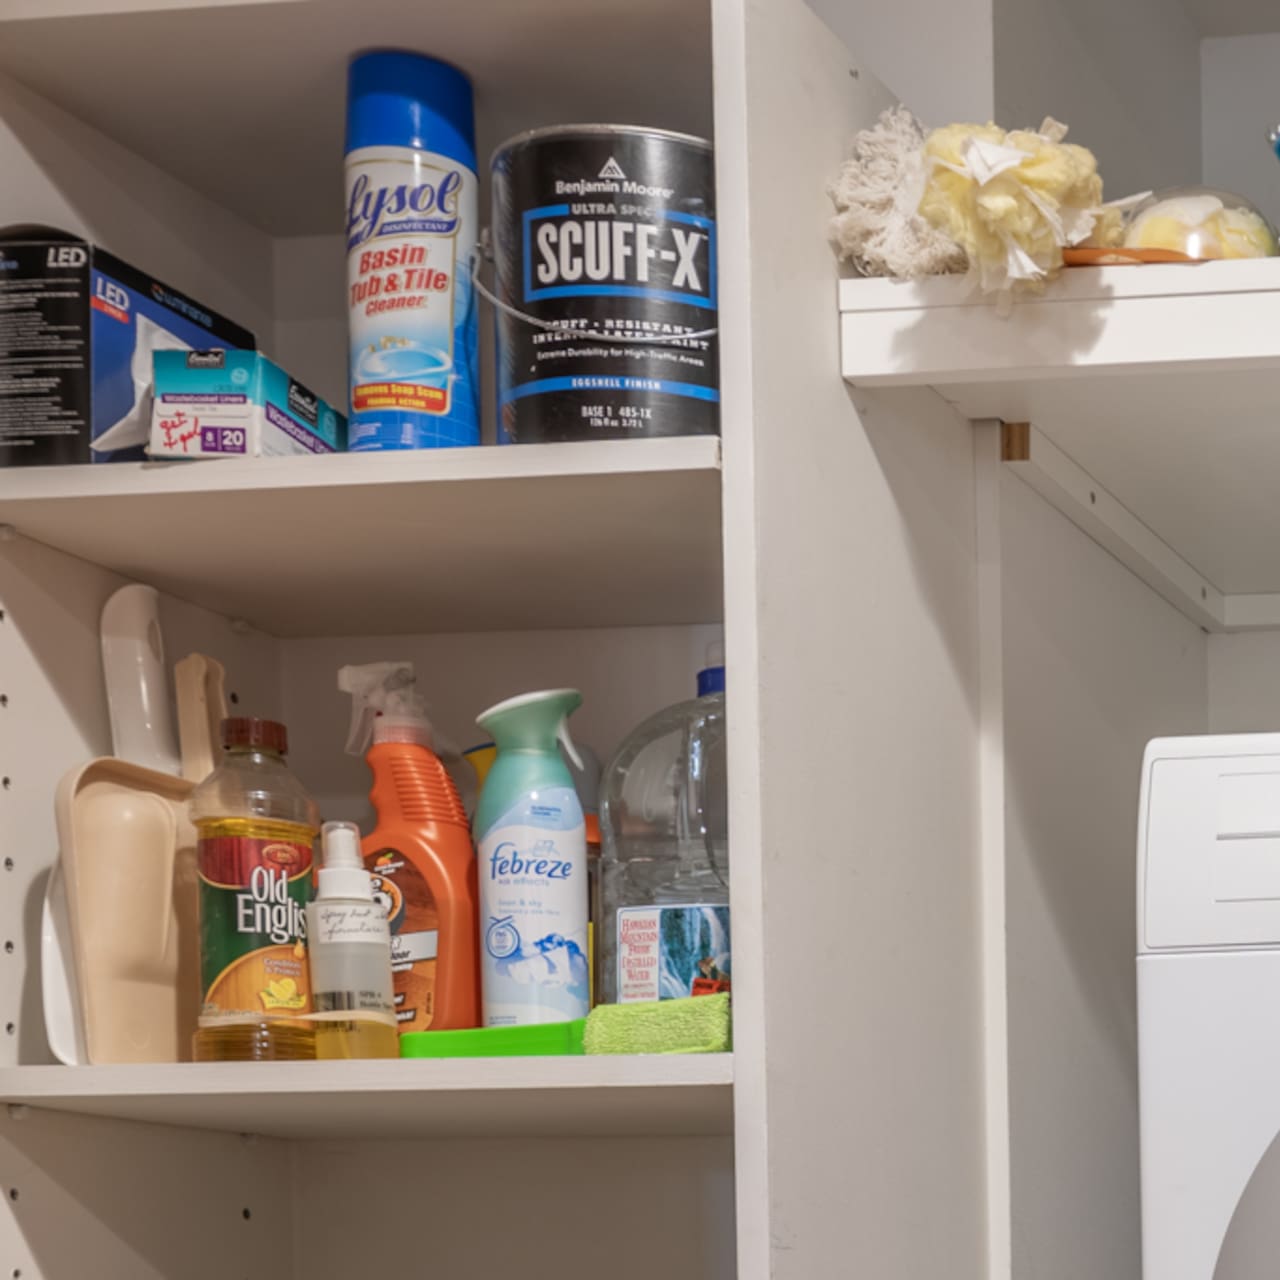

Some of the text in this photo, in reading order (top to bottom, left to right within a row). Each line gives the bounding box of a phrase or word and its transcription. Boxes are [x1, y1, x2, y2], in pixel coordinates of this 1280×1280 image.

[555, 178, 672, 198] Benjamin Moore
[345, 170, 461, 245] Lysol
[571, 202, 616, 215] ULTRA
[46, 246, 88, 268] LED
[359, 244, 426, 275] Basin
[536, 219, 703, 292] SCUFF-X
[96, 276, 130, 312] LED
[351, 268, 449, 306] Tub & Tile
[365, 296, 424, 317] Cleaner
[571, 378, 661, 390] EGGSHELL FINISH
[221, 430, 245, 446] 20
[490, 841, 573, 880] febreze
[251, 865, 289, 905] Old
[236, 892, 307, 943] Englis
